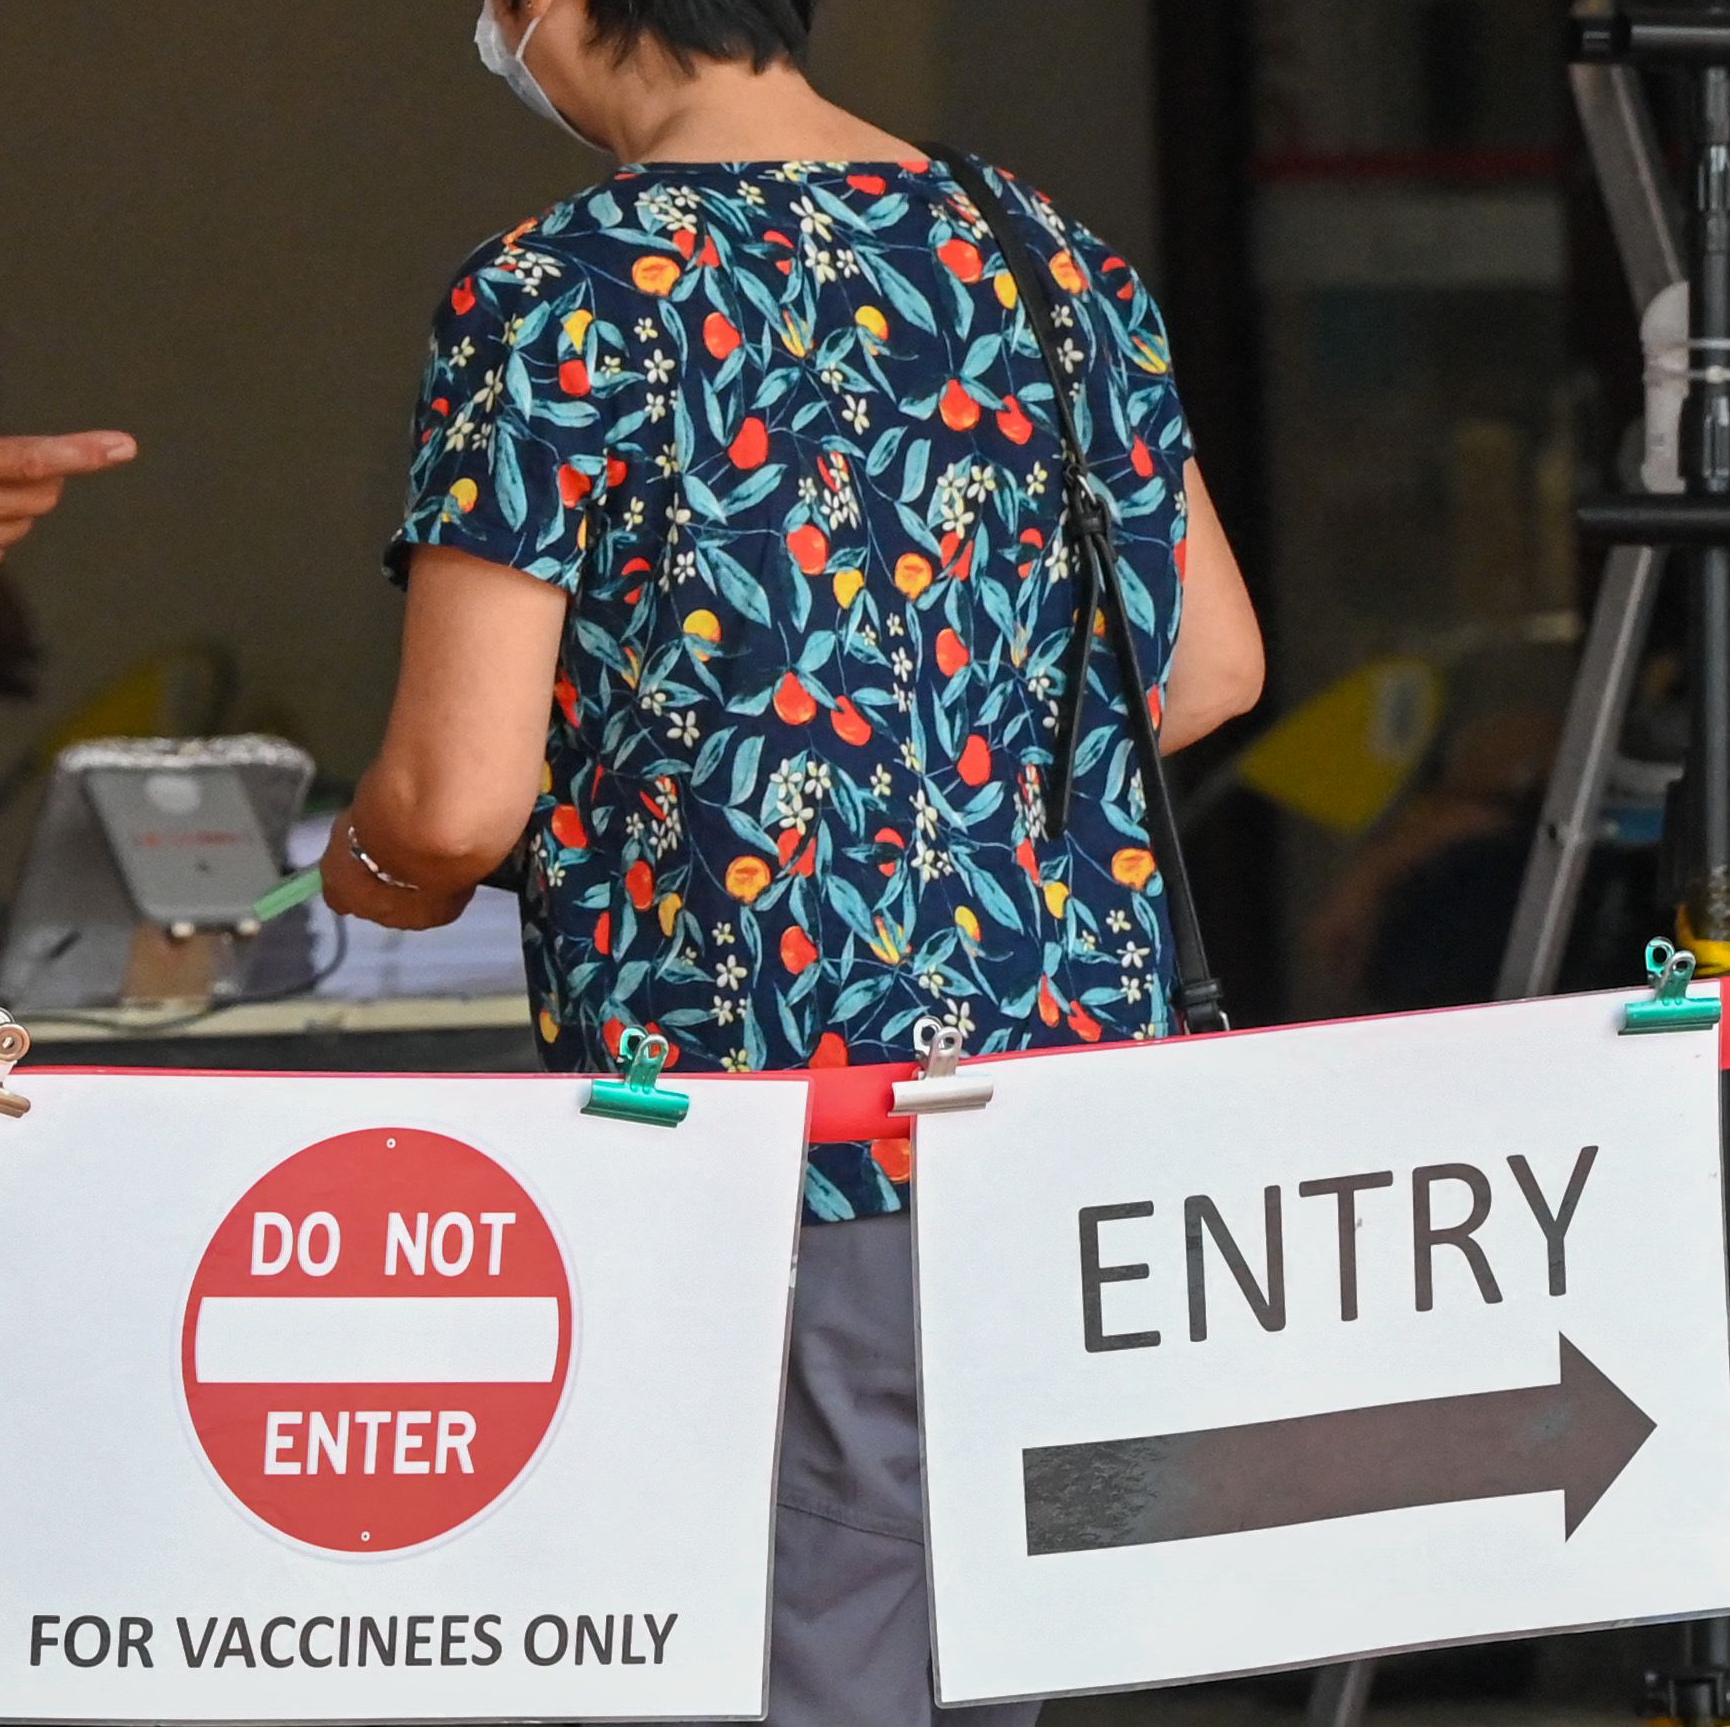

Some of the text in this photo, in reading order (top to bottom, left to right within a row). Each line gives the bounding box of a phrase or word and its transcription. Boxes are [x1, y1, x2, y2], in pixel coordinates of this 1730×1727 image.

[251, 1211, 516, 1277] DO NOT
[1079, 1146, 1598, 1354] ENTRY
[264, 1411, 476, 1475] ENTER
[31, 1614, 678, 1668] FOR VACCINEES ONLY
